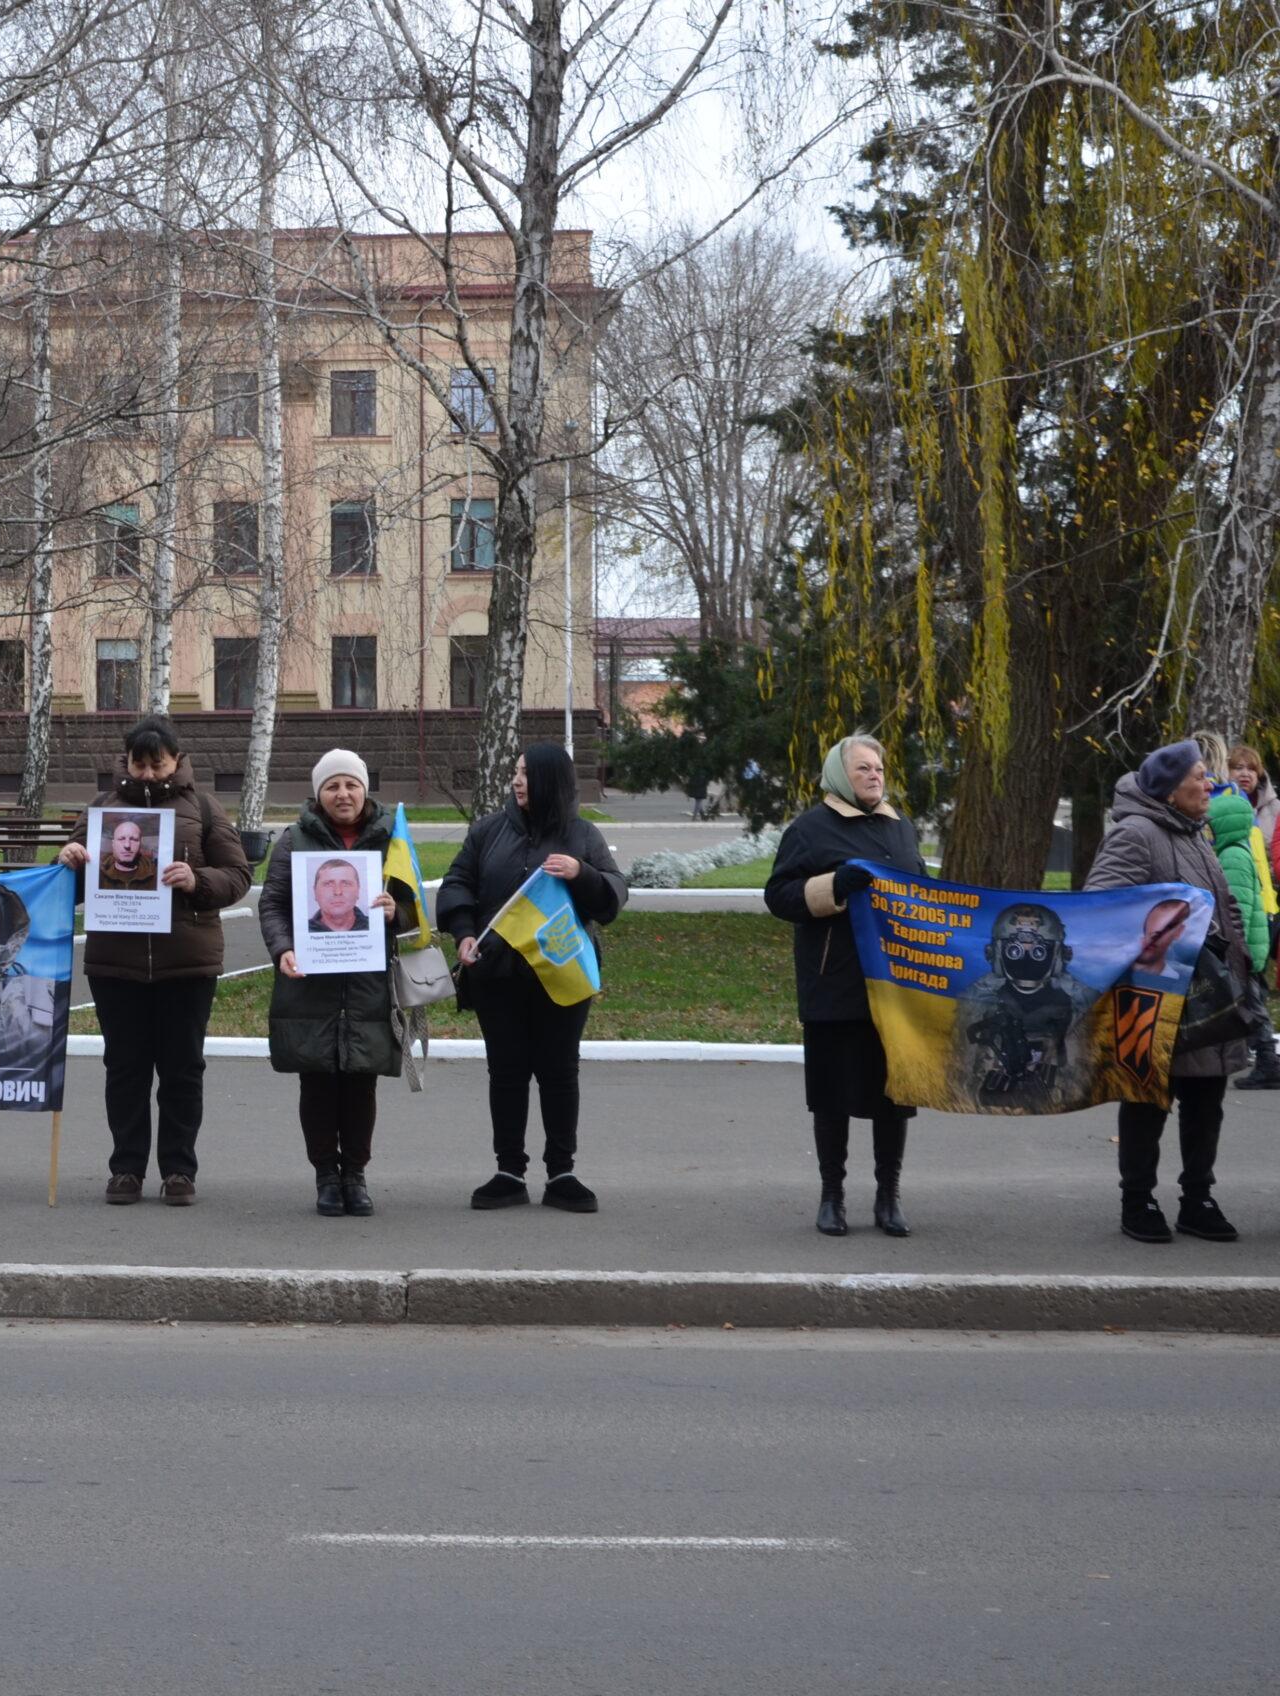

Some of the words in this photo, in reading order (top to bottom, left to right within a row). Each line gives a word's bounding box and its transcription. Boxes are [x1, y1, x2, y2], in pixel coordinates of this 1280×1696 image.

[870, 878, 908, 896] уріш
[910, 883, 980, 909] Радомир
[871, 893, 946, 924] 30.12.2005
[948, 912, 972, 928] р.н
[887, 941, 963, 970] штурмова
